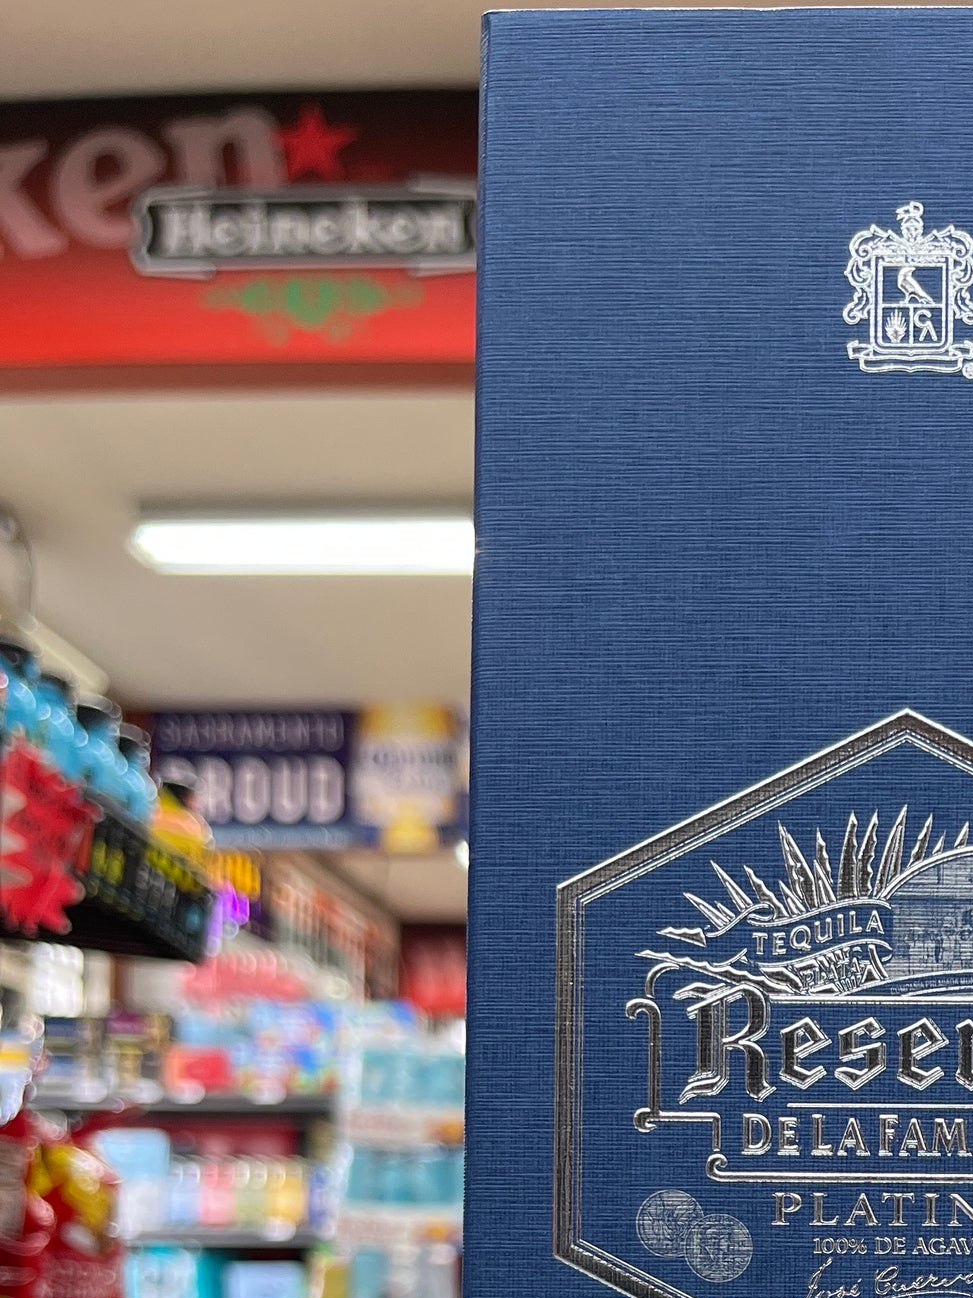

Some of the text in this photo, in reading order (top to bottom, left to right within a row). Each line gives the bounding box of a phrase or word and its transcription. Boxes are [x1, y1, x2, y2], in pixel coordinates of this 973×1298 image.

[752, 909, 885, 956] TEQUILA
[740, 1113, 801, 1157] DE
[811, 1113, 871, 1157] LA
[812, 1236, 868, 1256] 100%
[874, 1236, 906, 1255] DE
